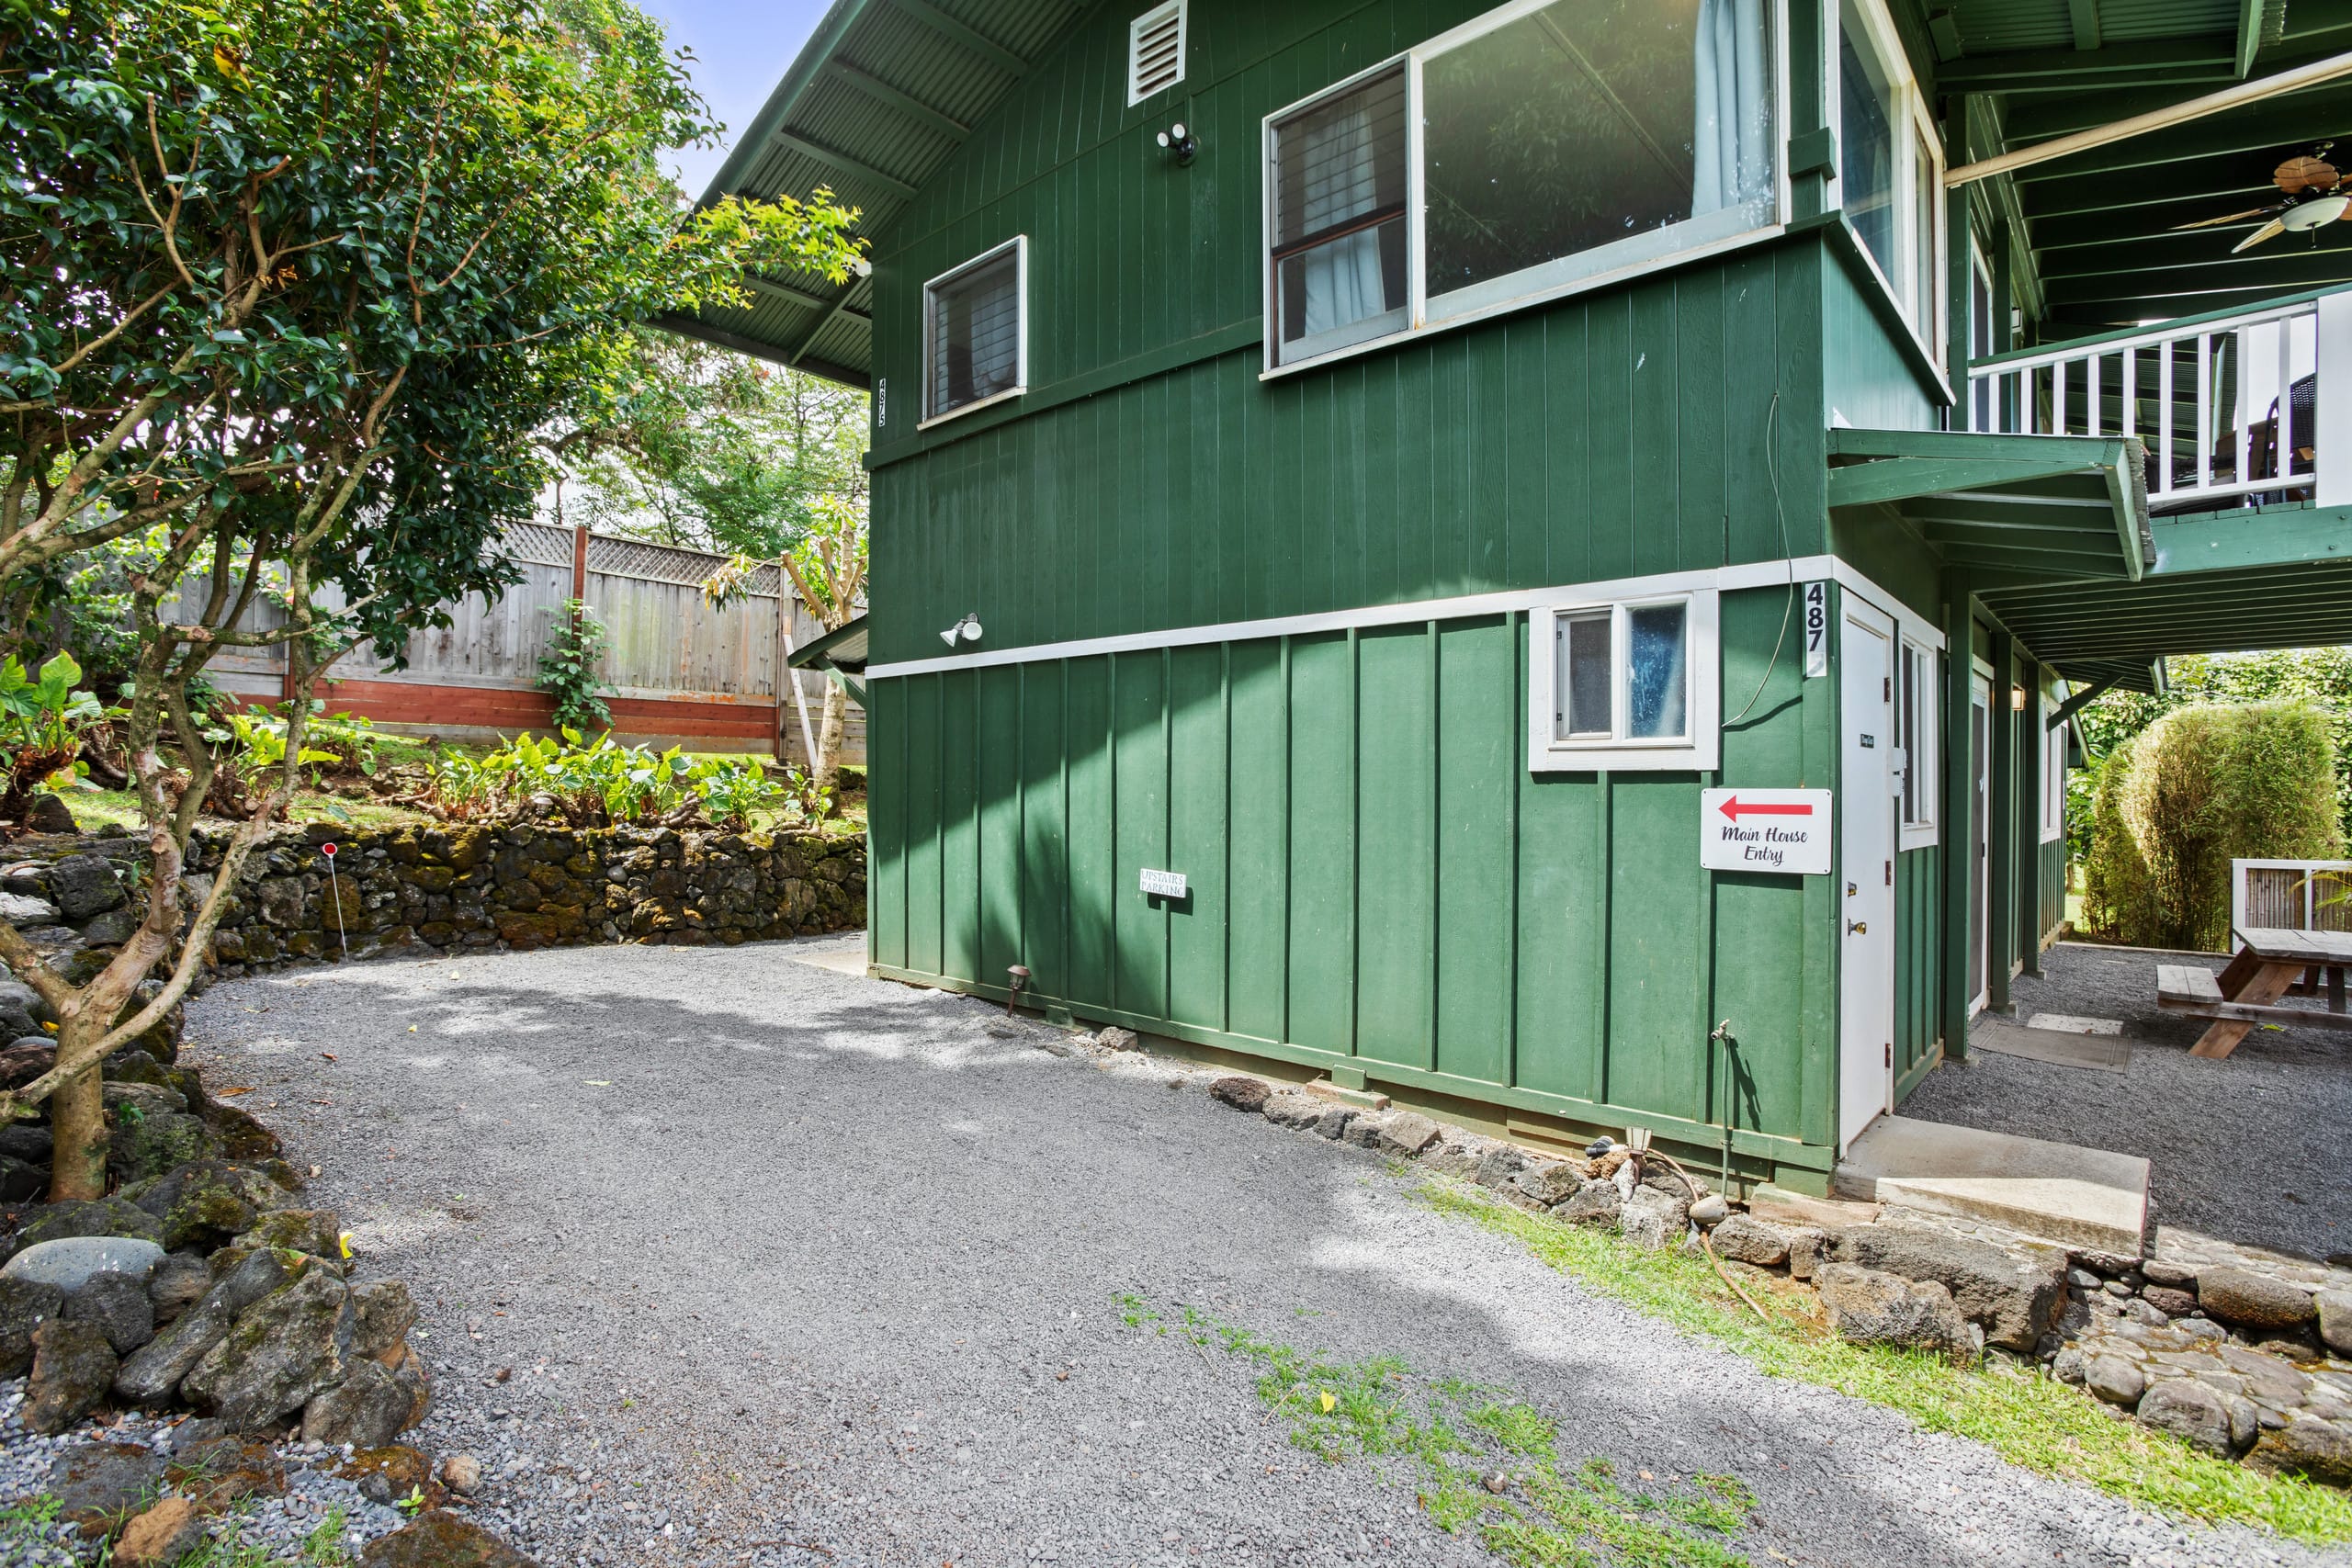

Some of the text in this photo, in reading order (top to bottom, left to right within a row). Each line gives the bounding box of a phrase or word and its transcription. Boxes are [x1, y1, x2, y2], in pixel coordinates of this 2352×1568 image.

[1807, 583, 1824, 652] 487
[1721, 826, 1807, 843] Main House
[1744, 845, 1784, 866] Entry
[1141, 870, 1183, 885] UPSTAIRS
[1141, 882, 1183, 897] PARKING
